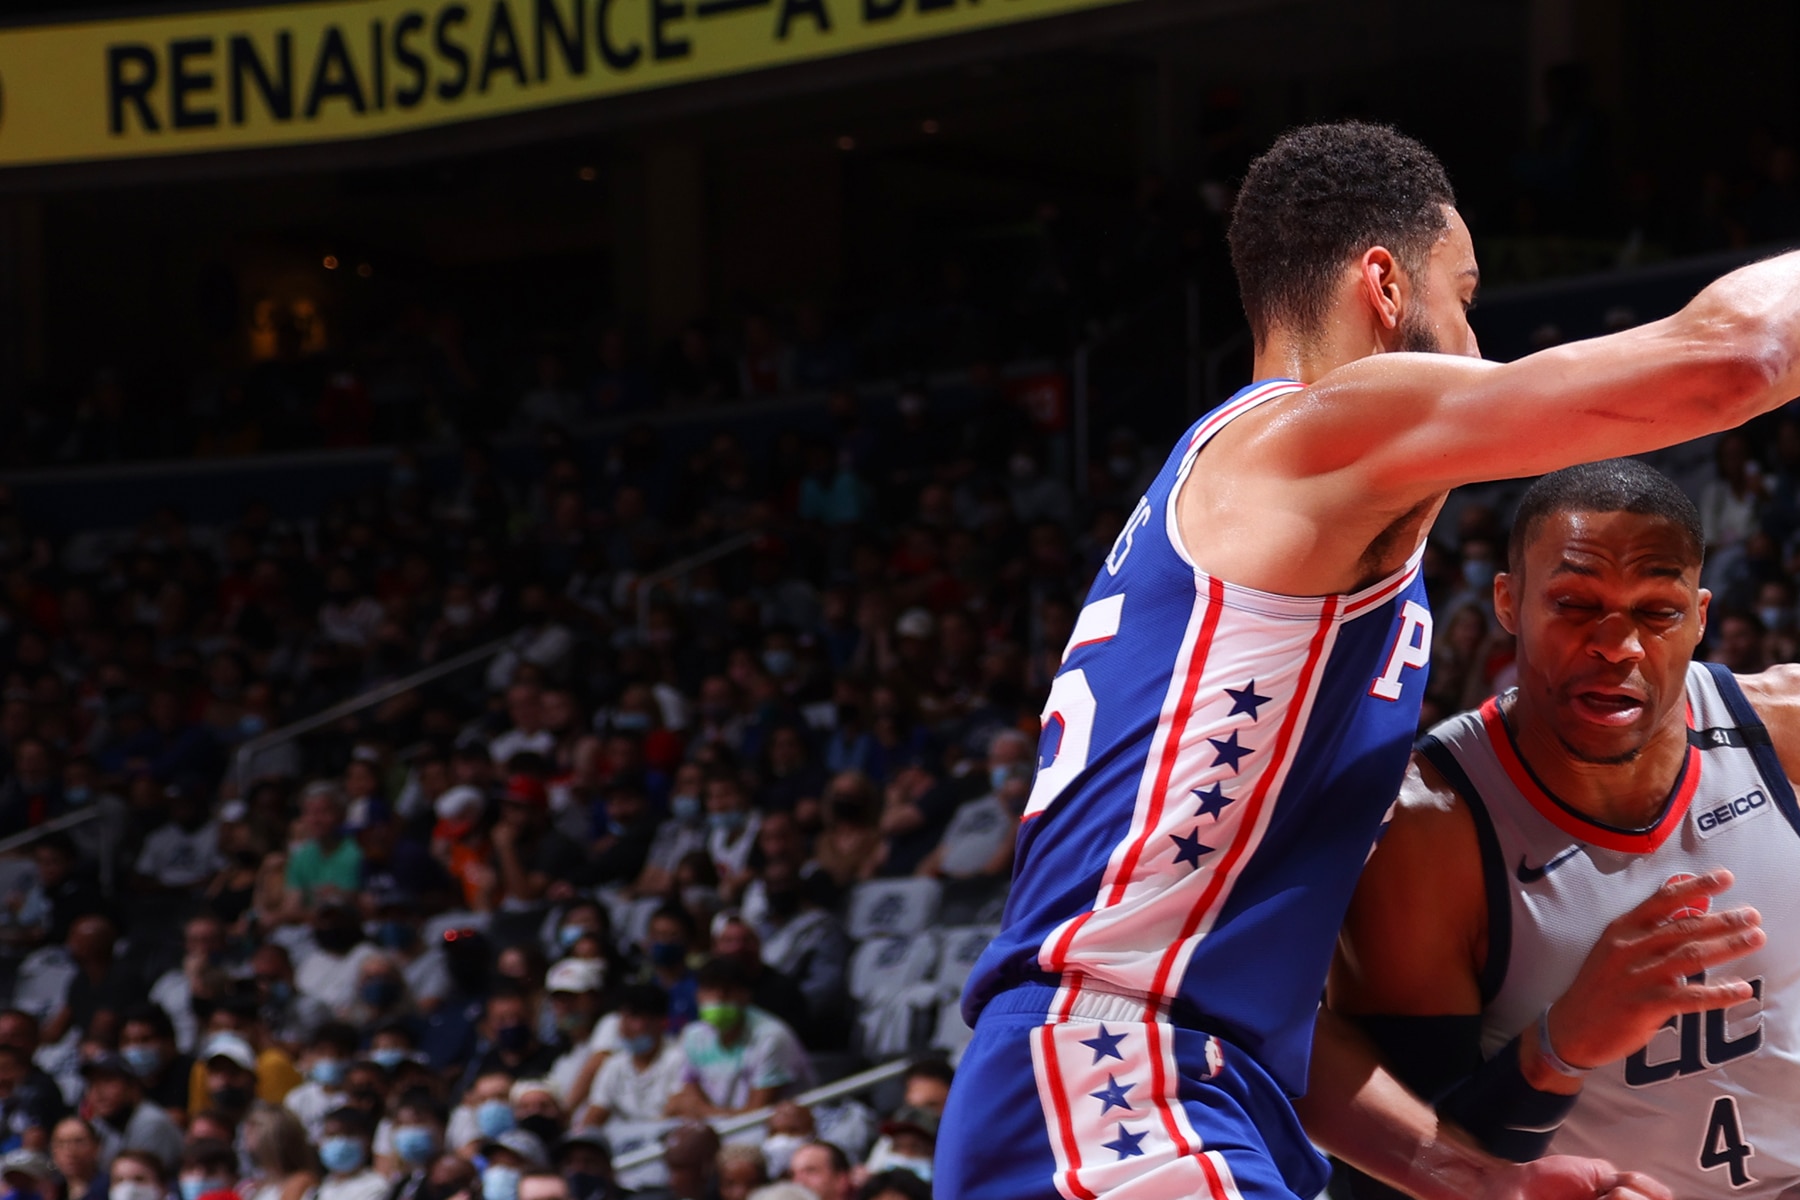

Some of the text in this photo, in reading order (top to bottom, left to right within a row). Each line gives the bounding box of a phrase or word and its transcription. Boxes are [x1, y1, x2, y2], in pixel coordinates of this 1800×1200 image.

[1368, 600, 1433, 702] P
[1711, 730, 1732, 746] 41
[1697, 790, 1766, 832] GEICO
[1698, 1095, 1759, 1190] 4
